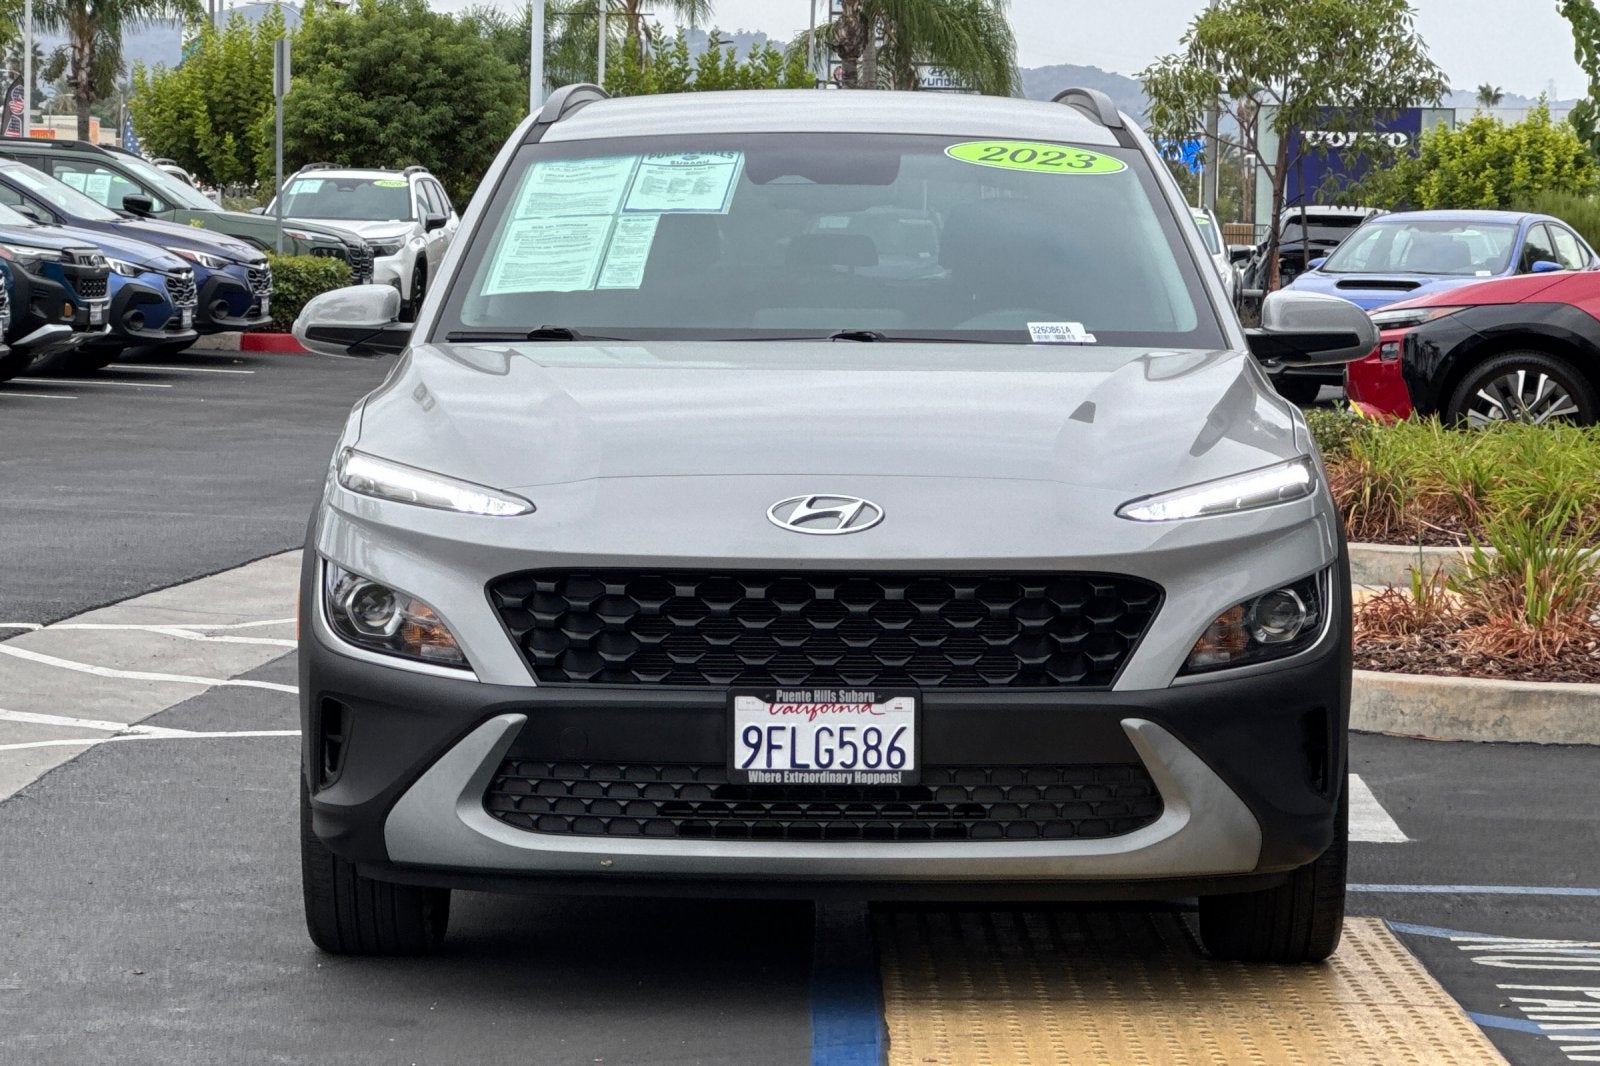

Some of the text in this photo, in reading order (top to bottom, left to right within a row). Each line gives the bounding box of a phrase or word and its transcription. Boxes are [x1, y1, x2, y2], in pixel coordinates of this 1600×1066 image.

[1300, 130, 1409, 149] VOLO
[977, 146, 1098, 169] 2023
[776, 689, 875, 703] Puente Hills Subaru
[769, 702, 886, 722] California
[742, 725, 908, 769] 9FLG586
[748, 771, 902, 785] Where Extraordinary Happens!
